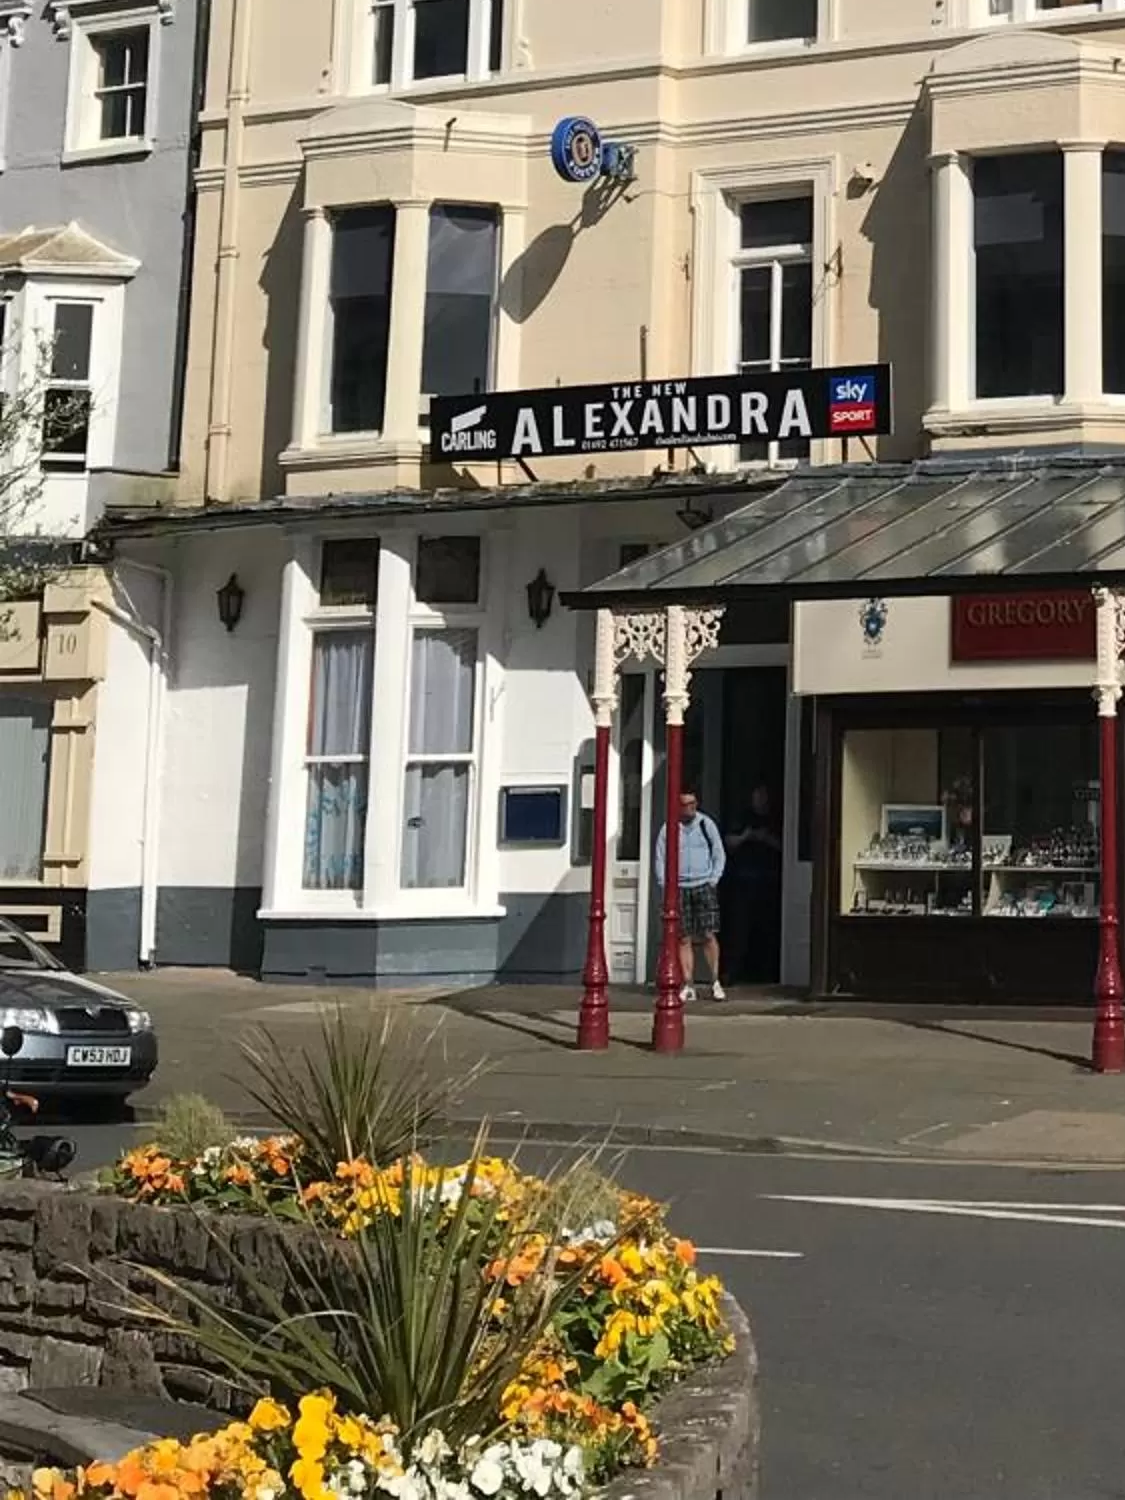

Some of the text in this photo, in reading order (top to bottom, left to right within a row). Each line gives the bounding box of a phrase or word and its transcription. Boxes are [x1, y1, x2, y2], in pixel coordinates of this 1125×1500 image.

[611, 381, 687, 399] THE NEW
[836, 379, 868, 403] sky
[511, 389, 812, 455] ALEXANDRA
[832, 409, 874, 423] SPORT
[441, 429, 497, 452] CARLING
[966, 596, 1087, 626] GREGORY
[56, 632, 78, 655] 10
